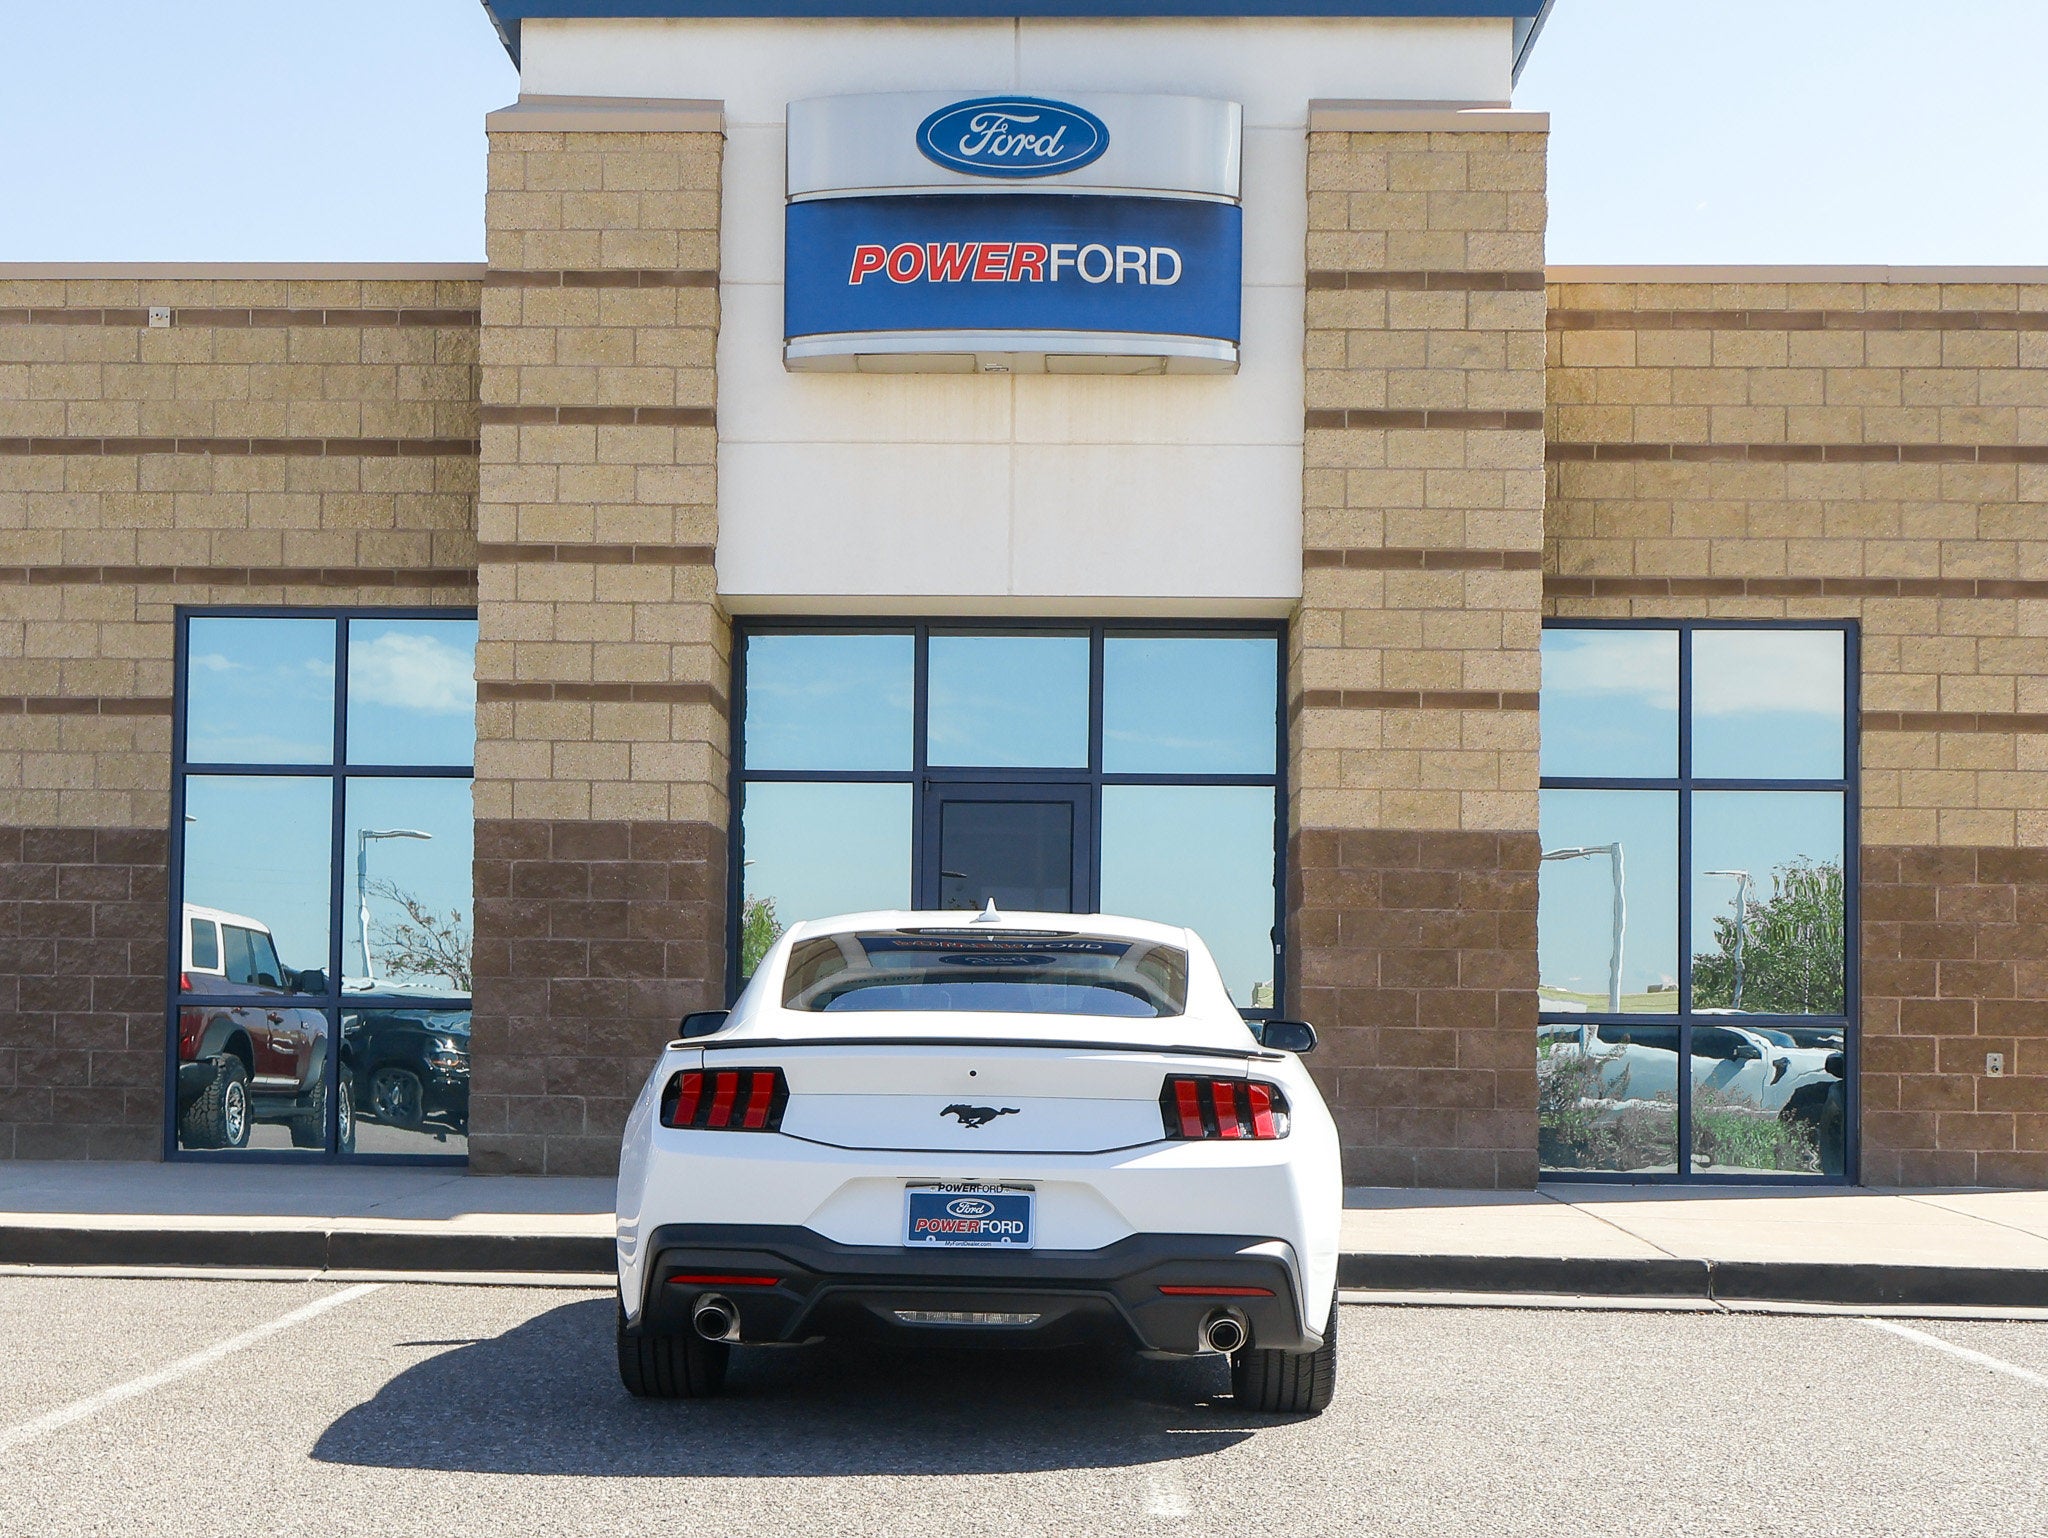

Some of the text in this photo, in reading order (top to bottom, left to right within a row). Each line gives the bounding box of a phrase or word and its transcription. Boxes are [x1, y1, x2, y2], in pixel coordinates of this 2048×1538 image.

[959, 111, 1067, 157] Ford
[848, 242, 1183, 286] POWERFORD
[938, 1183, 1004, 1194] POWERFORD
[956, 1202, 984, 1214] Ford
[915, 1218, 1024, 1234] POWERFORD
